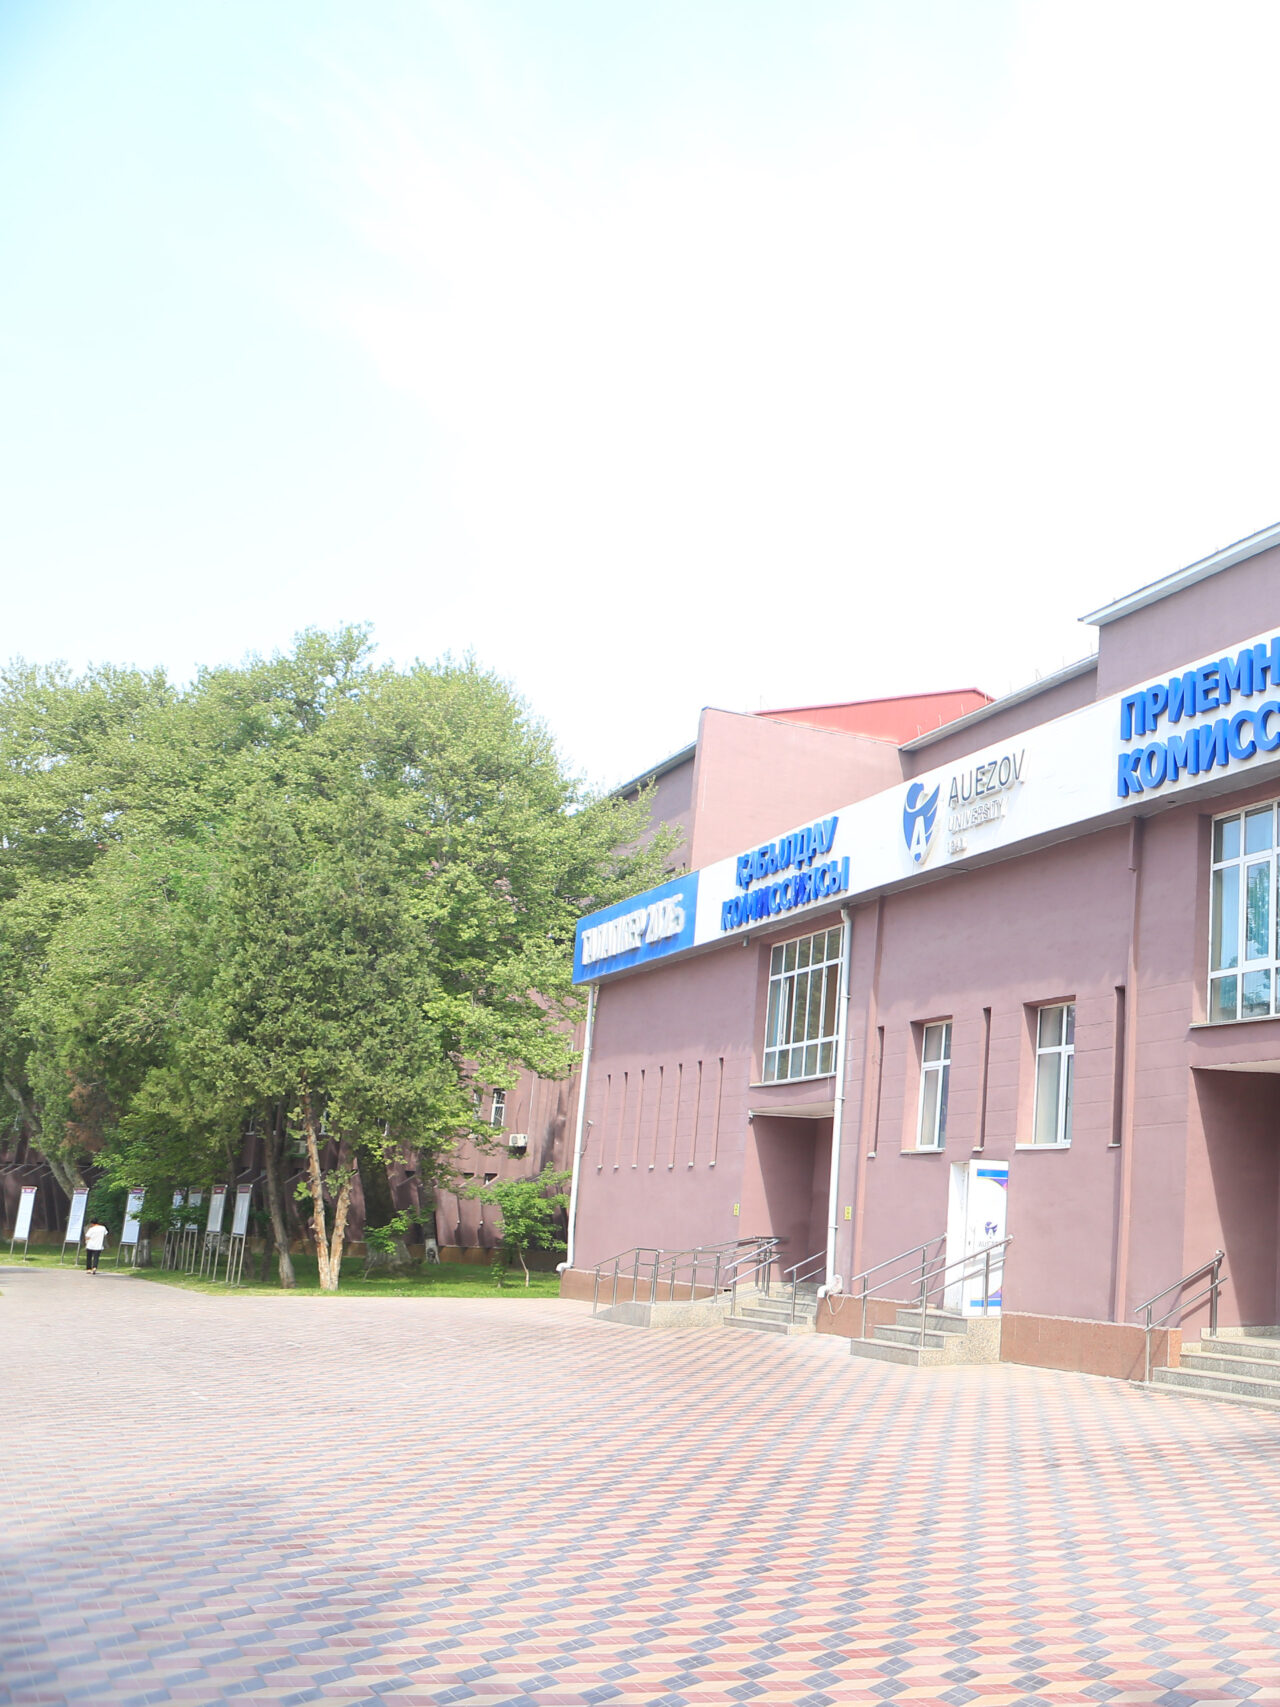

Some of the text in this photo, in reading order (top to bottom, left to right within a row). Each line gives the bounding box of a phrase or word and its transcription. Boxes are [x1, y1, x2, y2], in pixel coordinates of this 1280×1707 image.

[948, 748, 1026, 808] AUEZOV
[947, 796, 1009, 833] UNIVERSITY
[736, 815, 840, 891] ҚАБЫЛДАУ
[720, 855, 851, 931] КОМИССИЯСЫ
